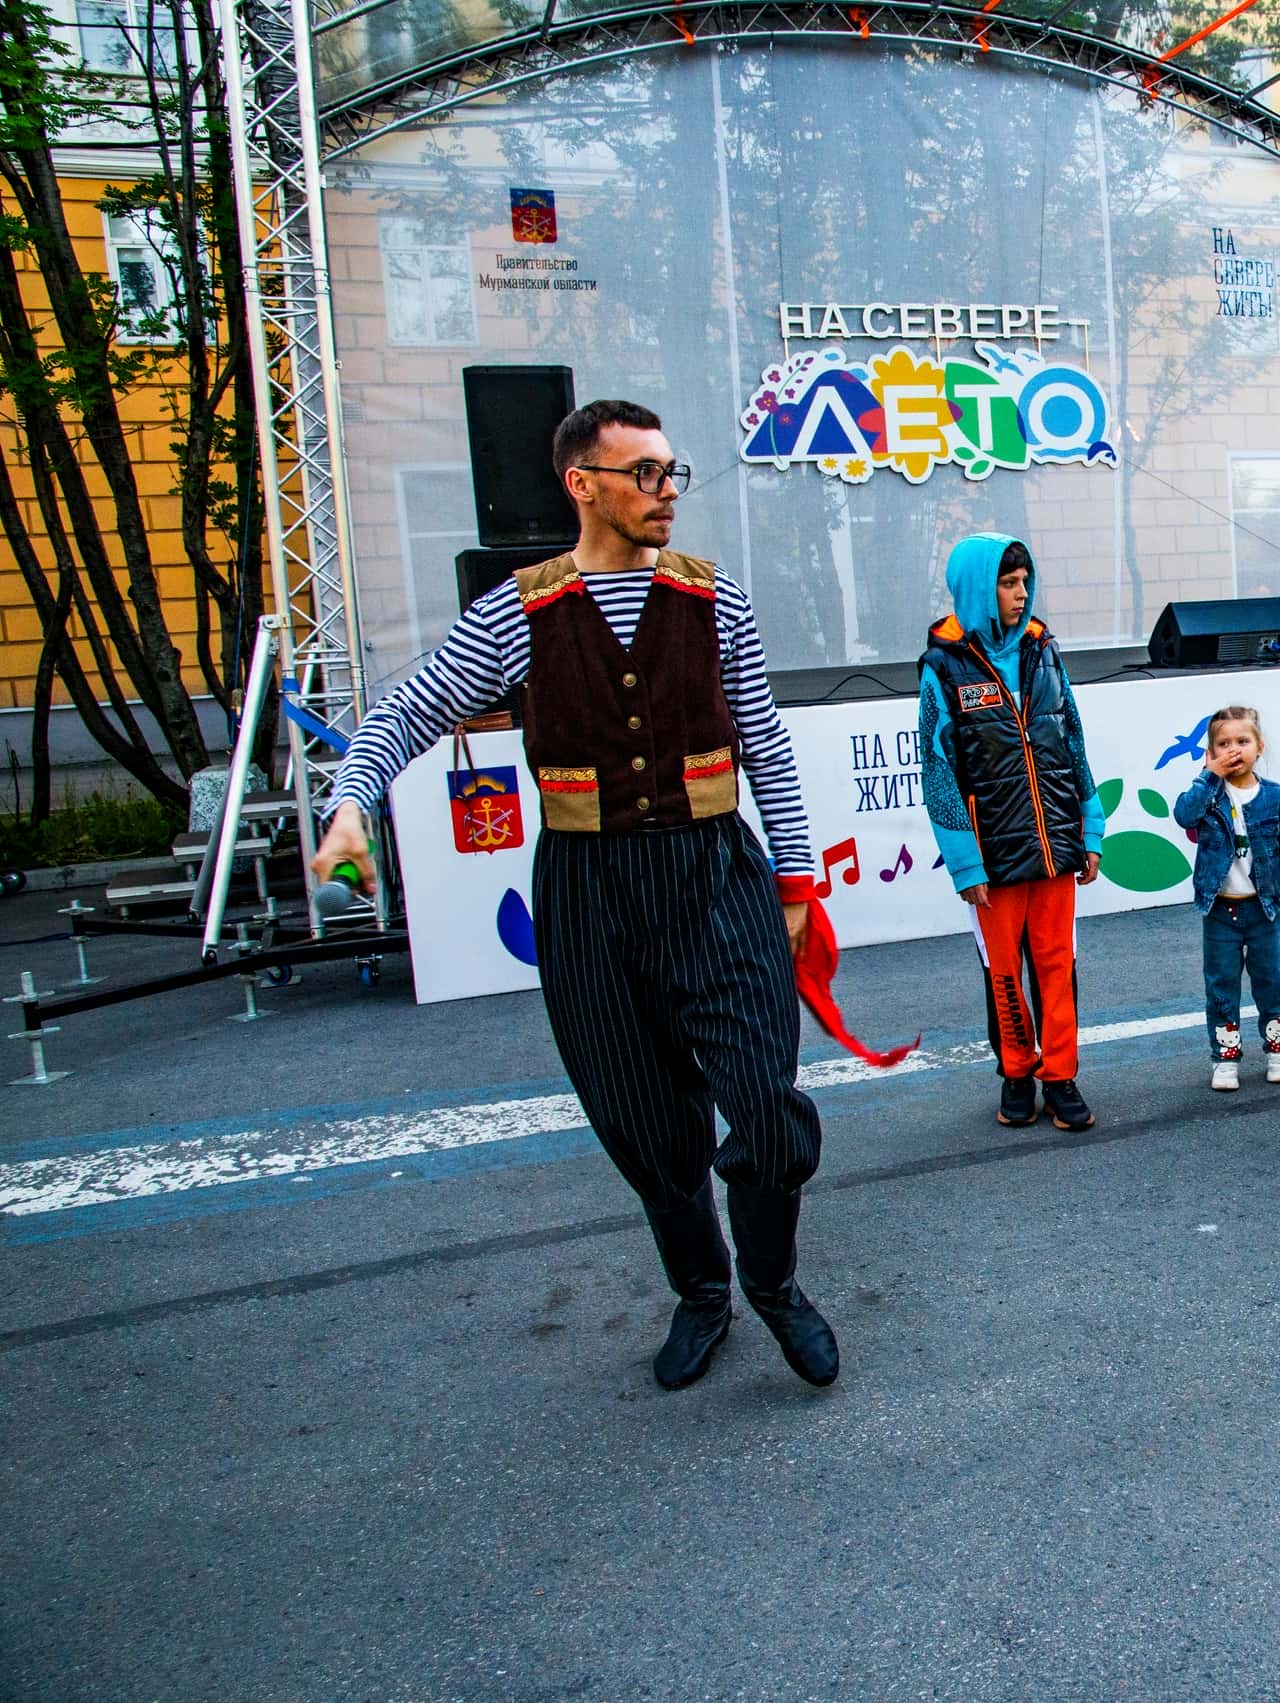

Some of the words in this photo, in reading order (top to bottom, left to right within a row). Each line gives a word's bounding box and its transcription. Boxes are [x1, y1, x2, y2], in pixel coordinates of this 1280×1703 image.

[1212, 227, 1236, 255] НА
[496, 254, 578, 272] Правительство
[1214, 258, 1274, 288] СЕВЕРЕ
[479, 273, 550, 292] Мурманской
[553, 275, 597, 291] области
[1216, 290, 1272, 318] ЖИТЬ!
[780, 303, 852, 338] НА
[862, 303, 1059, 339] СЕВЕРЕ
[790, 380, 1096, 456] ЛЕТО
[850, 733, 888, 770] НА
[854, 772, 926, 812] ЖИТ
